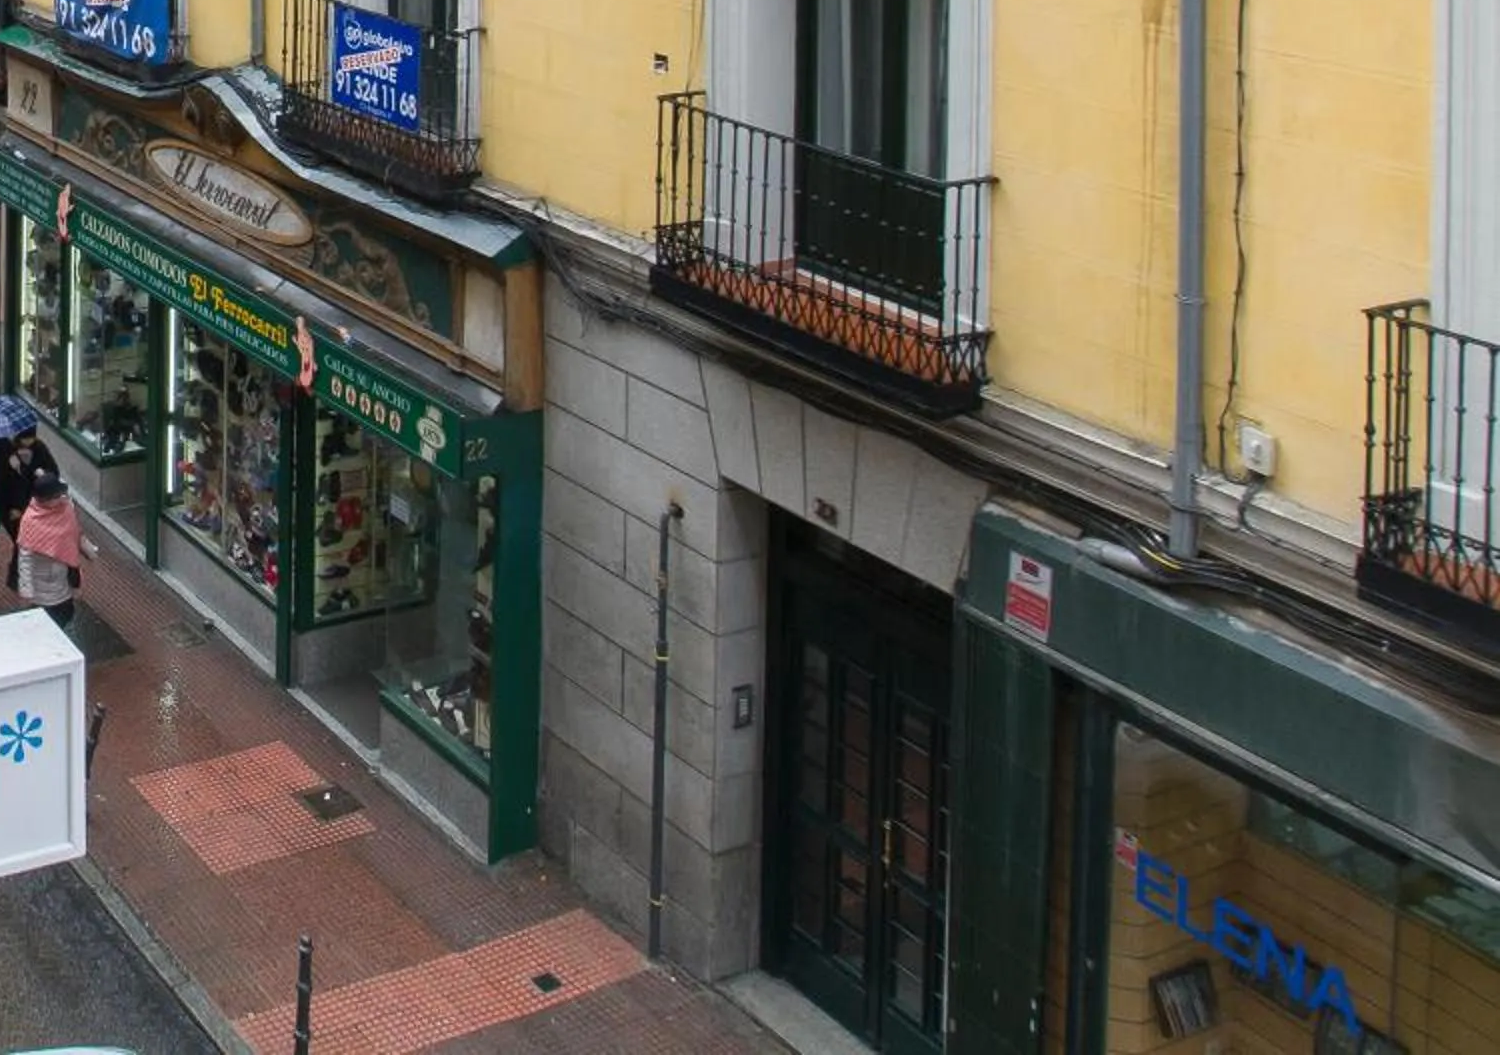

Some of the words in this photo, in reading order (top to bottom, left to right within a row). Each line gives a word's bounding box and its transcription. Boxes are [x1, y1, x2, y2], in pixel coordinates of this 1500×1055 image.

[81, 7, 109, 41] 324
[132, 24, 156, 57] 68
[336, 68, 351, 95] 91
[354, 75, 379, 105] 324
[381, 85, 396, 112] 11
[400, 92, 417, 120] 68
[81, 211, 130, 254] CALZADOS
[189, 273, 207, 300] El
[211, 285, 288, 348] Ferrocarril
[235, 326, 289, 366] DELICADOS
[371, 382, 411, 413] ANCHO
[465, 438, 488, 461] 22
[1135, 850, 1363, 1038] ELENA
